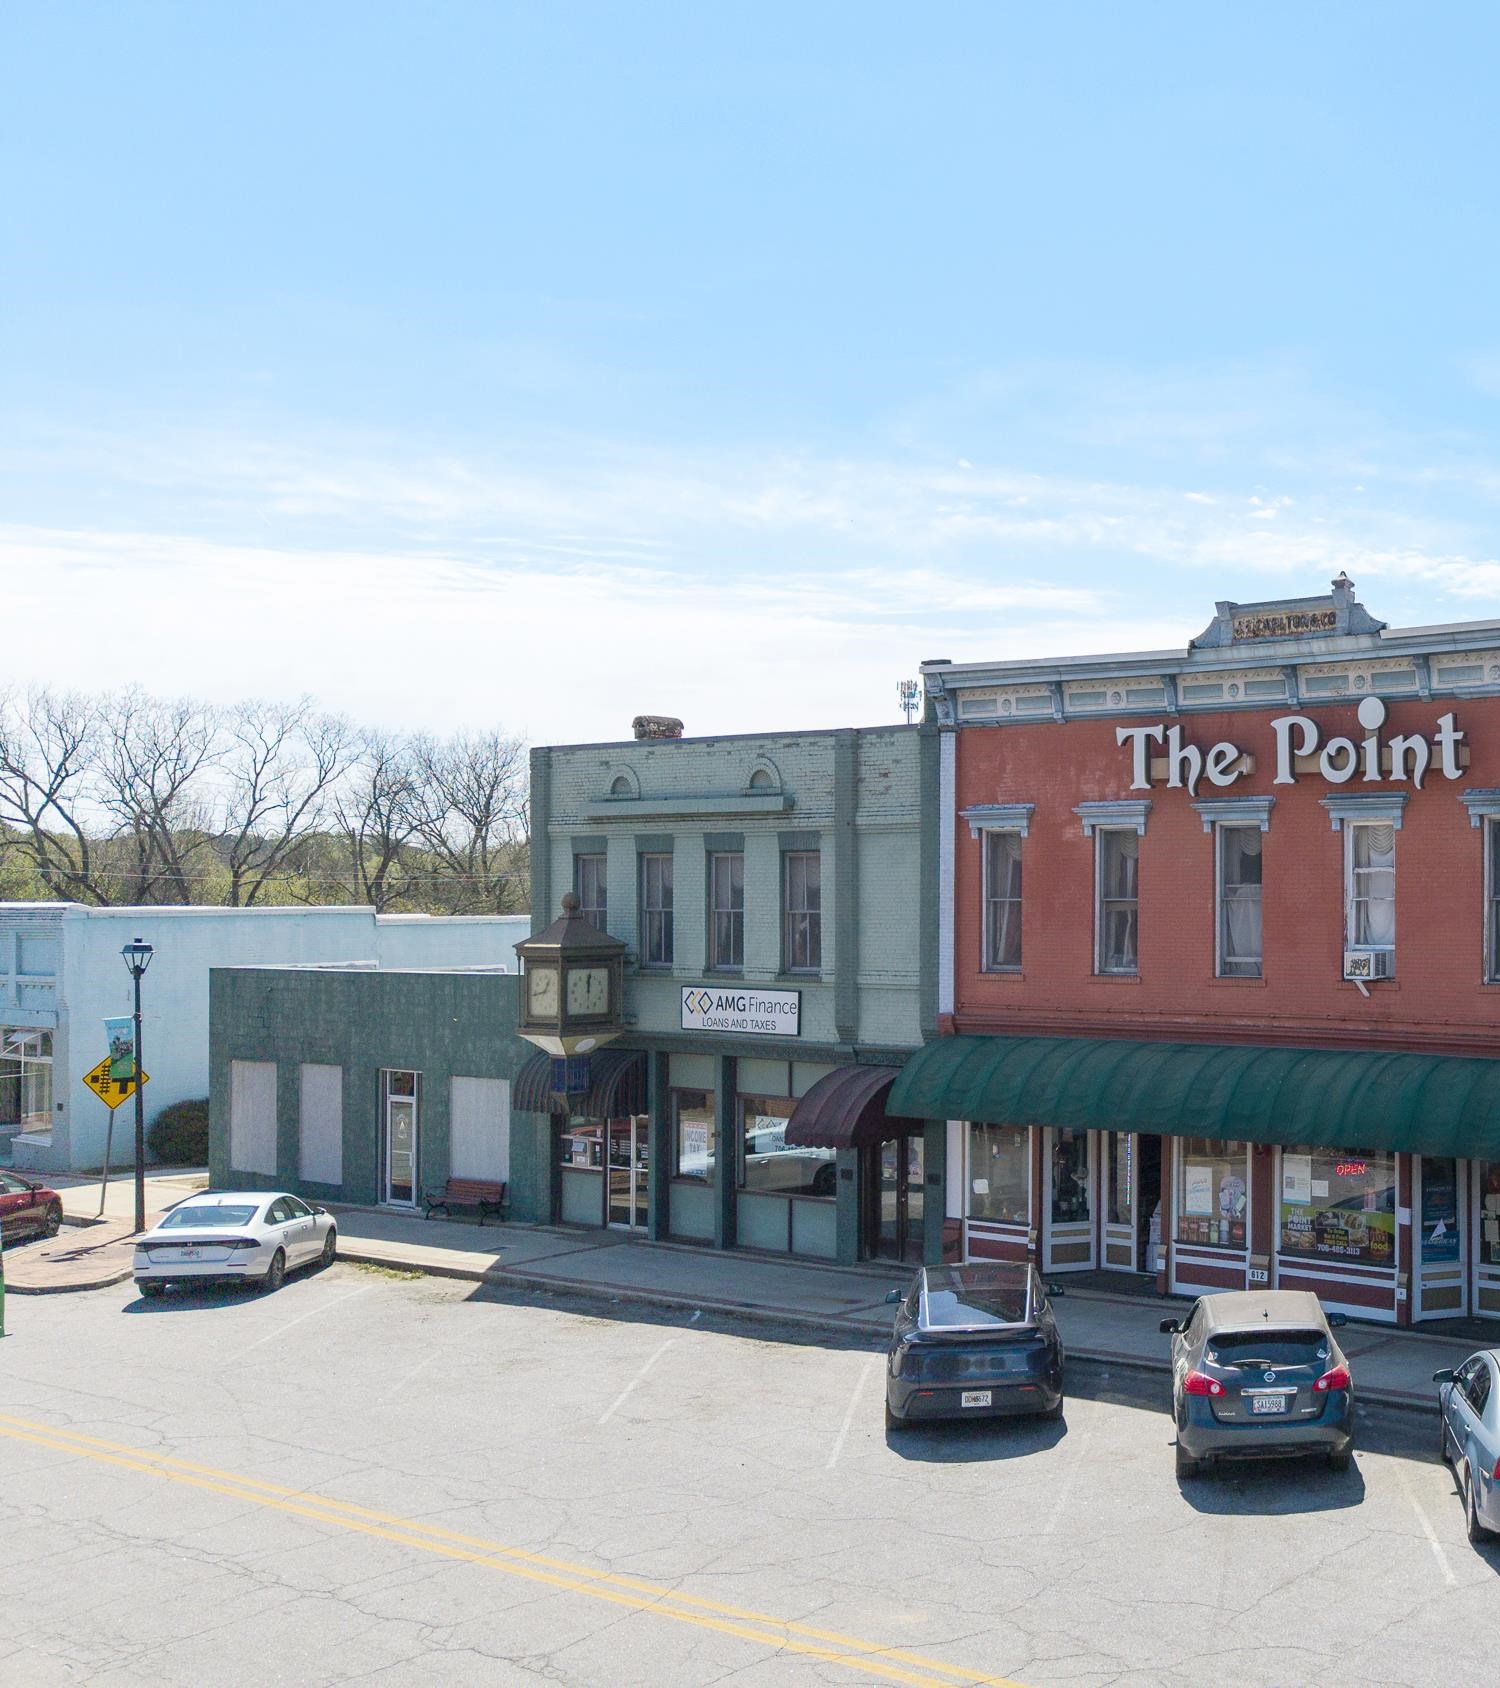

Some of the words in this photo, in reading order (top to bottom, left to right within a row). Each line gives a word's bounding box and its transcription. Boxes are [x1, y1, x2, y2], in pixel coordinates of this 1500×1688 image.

[1115, 724, 1249, 797] The
[1270, 696, 1464, 790] Point
[715, 995, 746, 1013] AMG
[748, 996, 798, 1015] Finance
[702, 1017, 729, 1028] LOANS
[731, 1018, 748, 1029] AND
[750, 1019, 777, 1031] TAXES
[1336, 1163, 1366, 1176] OPEN
[1290, 1207, 1304, 1215] THE
[1288, 1214, 1312, 1225] POINT
[1287, 1222, 1313, 1232] MARKET
[1251, 1270, 1265, 1280] 612
